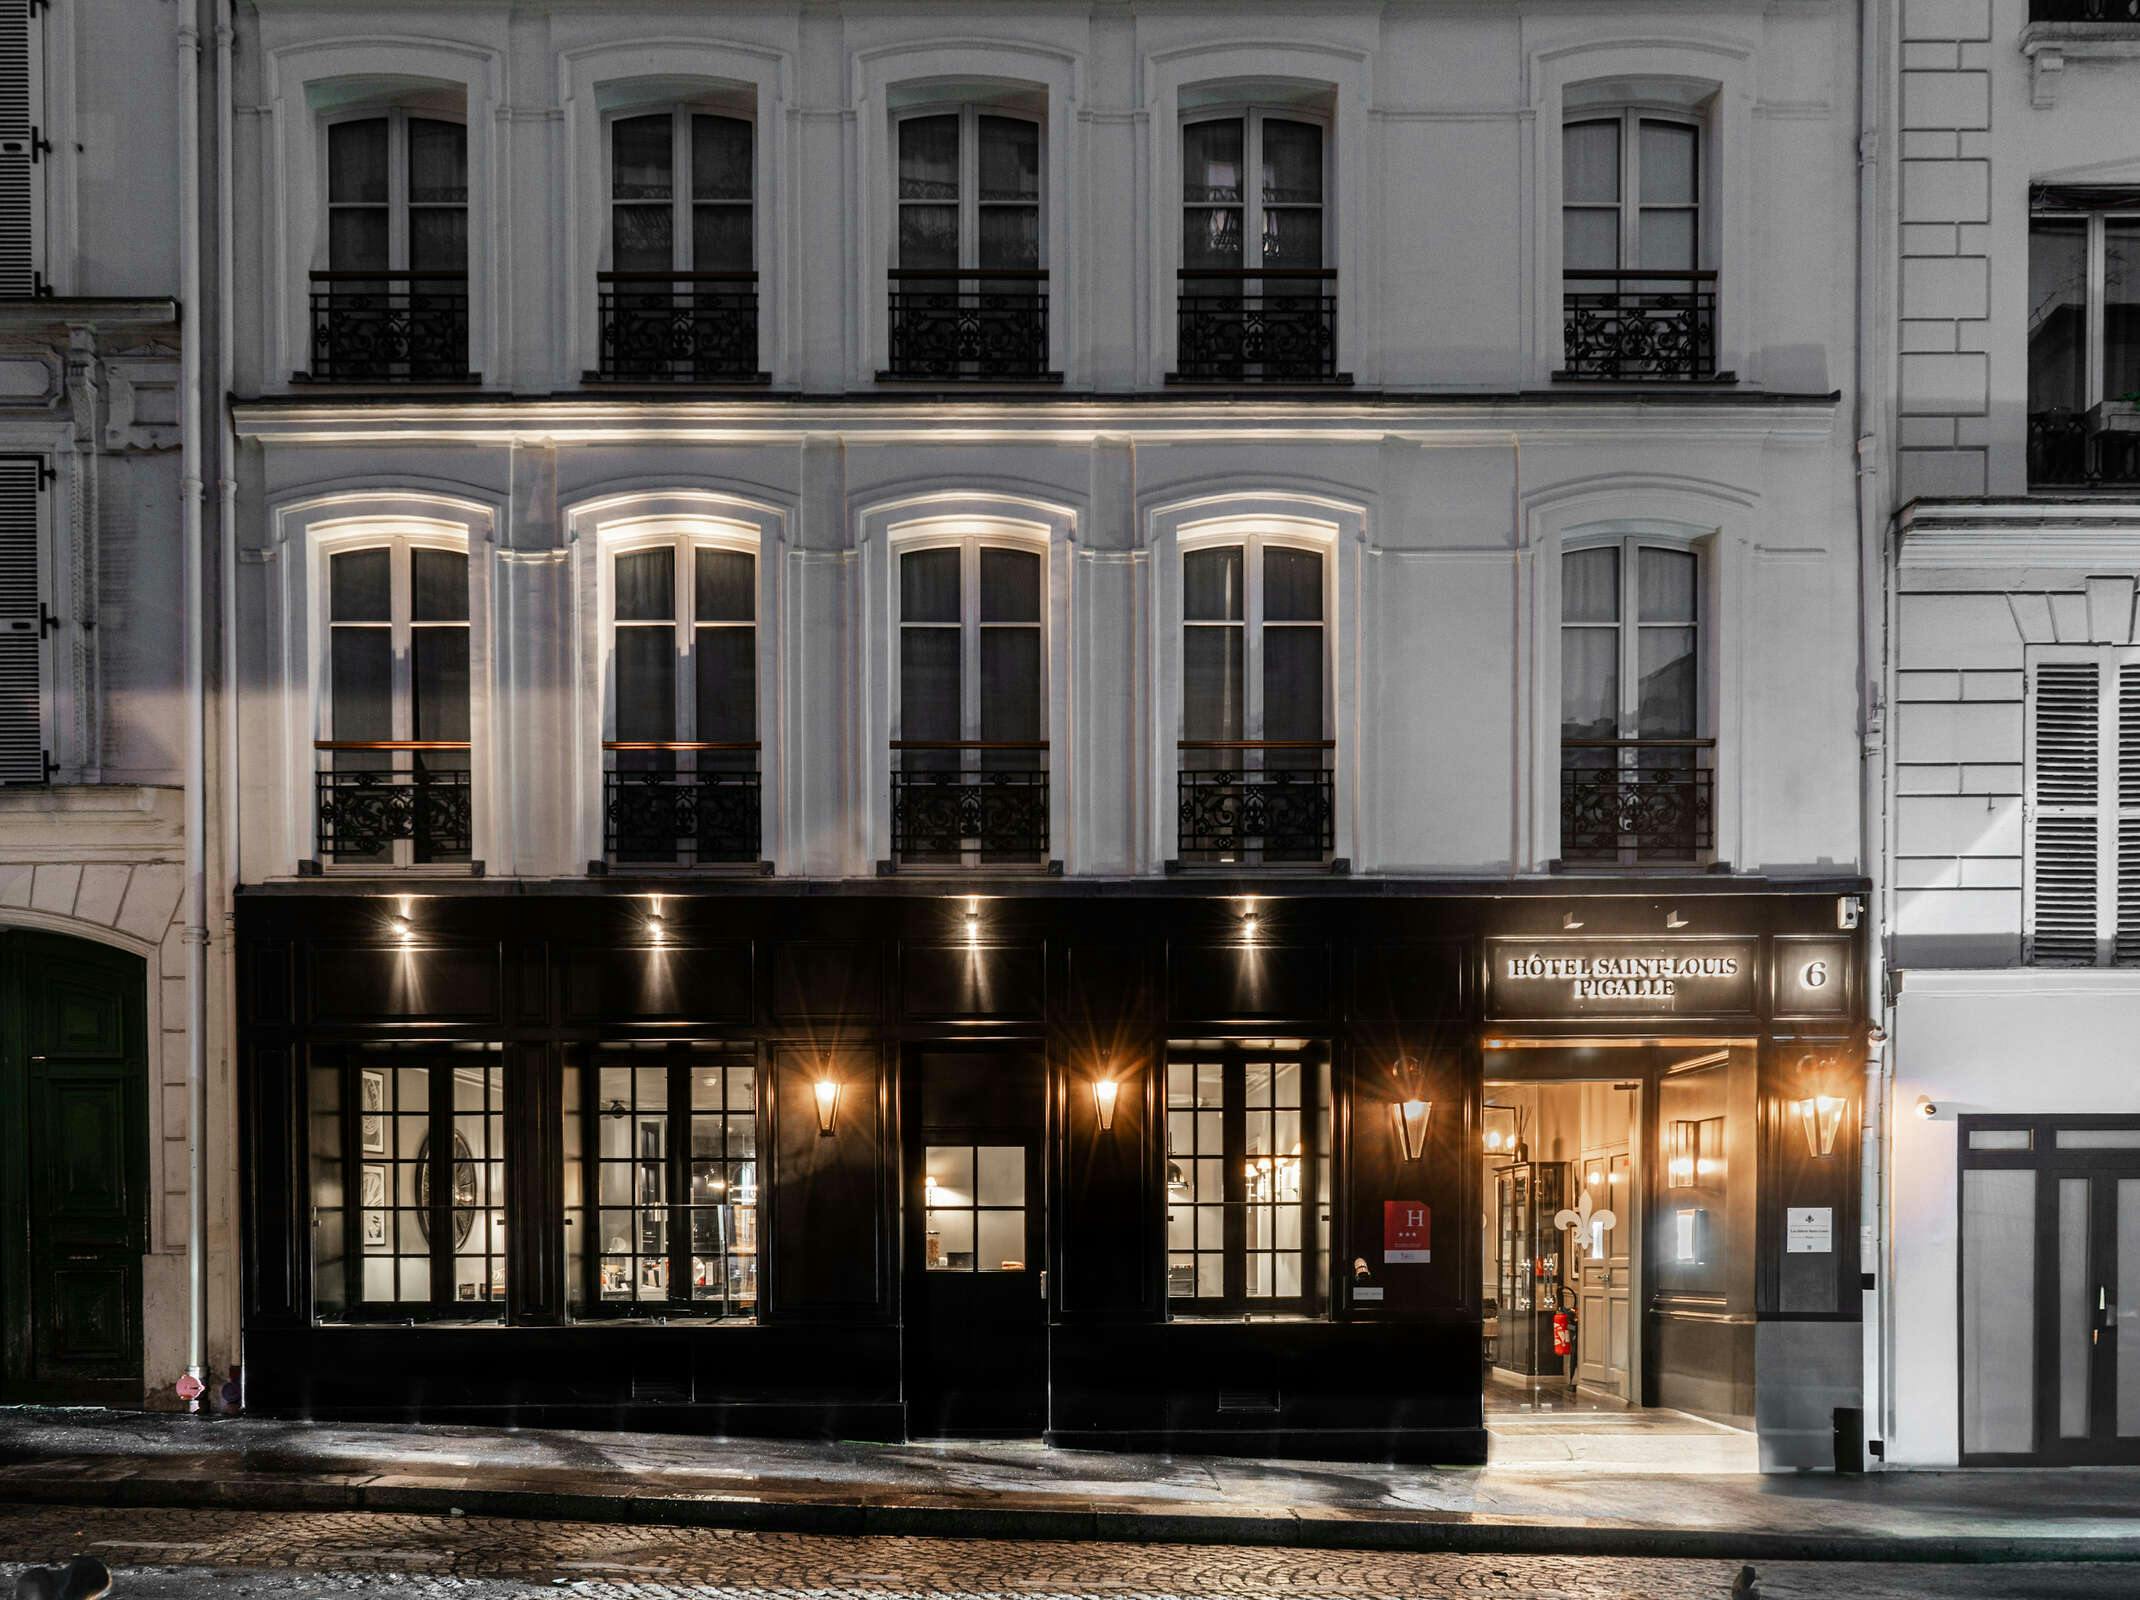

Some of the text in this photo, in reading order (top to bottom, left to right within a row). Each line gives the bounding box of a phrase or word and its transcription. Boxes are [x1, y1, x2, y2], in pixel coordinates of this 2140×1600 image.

[1511, 954, 1738, 977] HÔTEL SAINT-LOUIS
[1805, 962, 1827, 987] 6
[1578, 979, 1677, 998] PIGALLE
[1407, 1209, 1424, 1227] H
